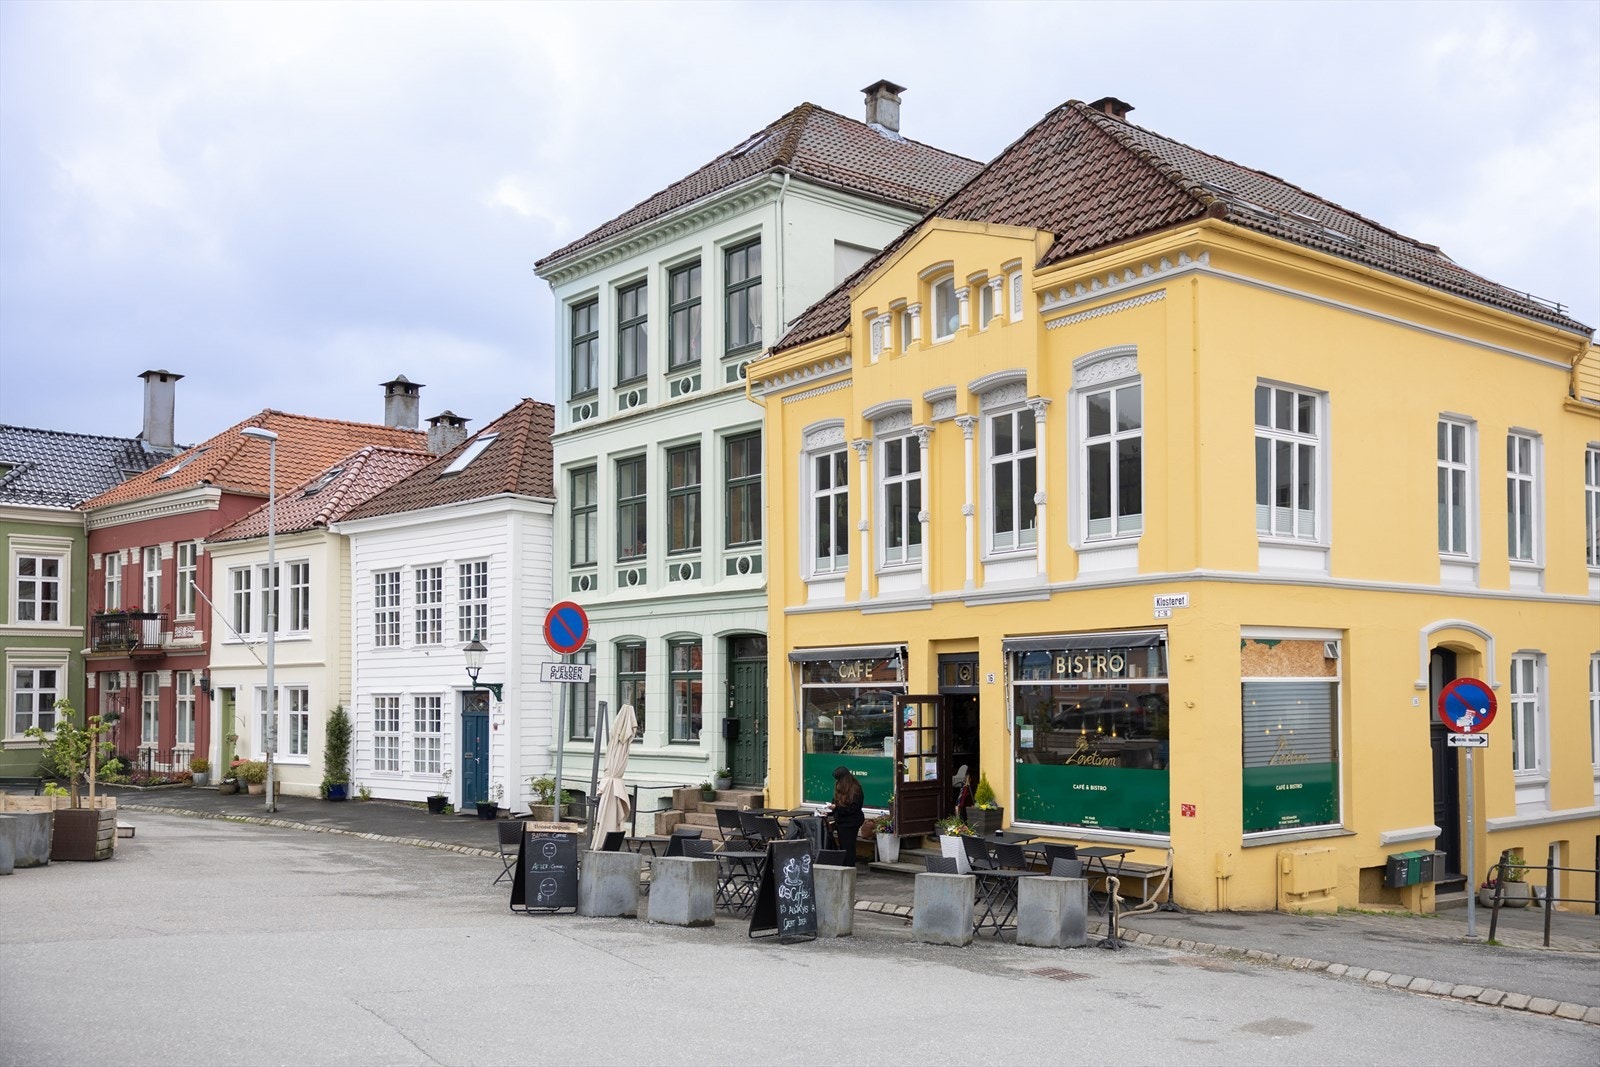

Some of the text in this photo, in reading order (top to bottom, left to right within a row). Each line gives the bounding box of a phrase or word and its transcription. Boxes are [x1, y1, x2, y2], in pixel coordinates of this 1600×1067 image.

[1156, 596, 1185, 607] Klosteret
[550, 665, 583, 674] GJELDER
[1056, 655, 1124, 674] BISTRO
